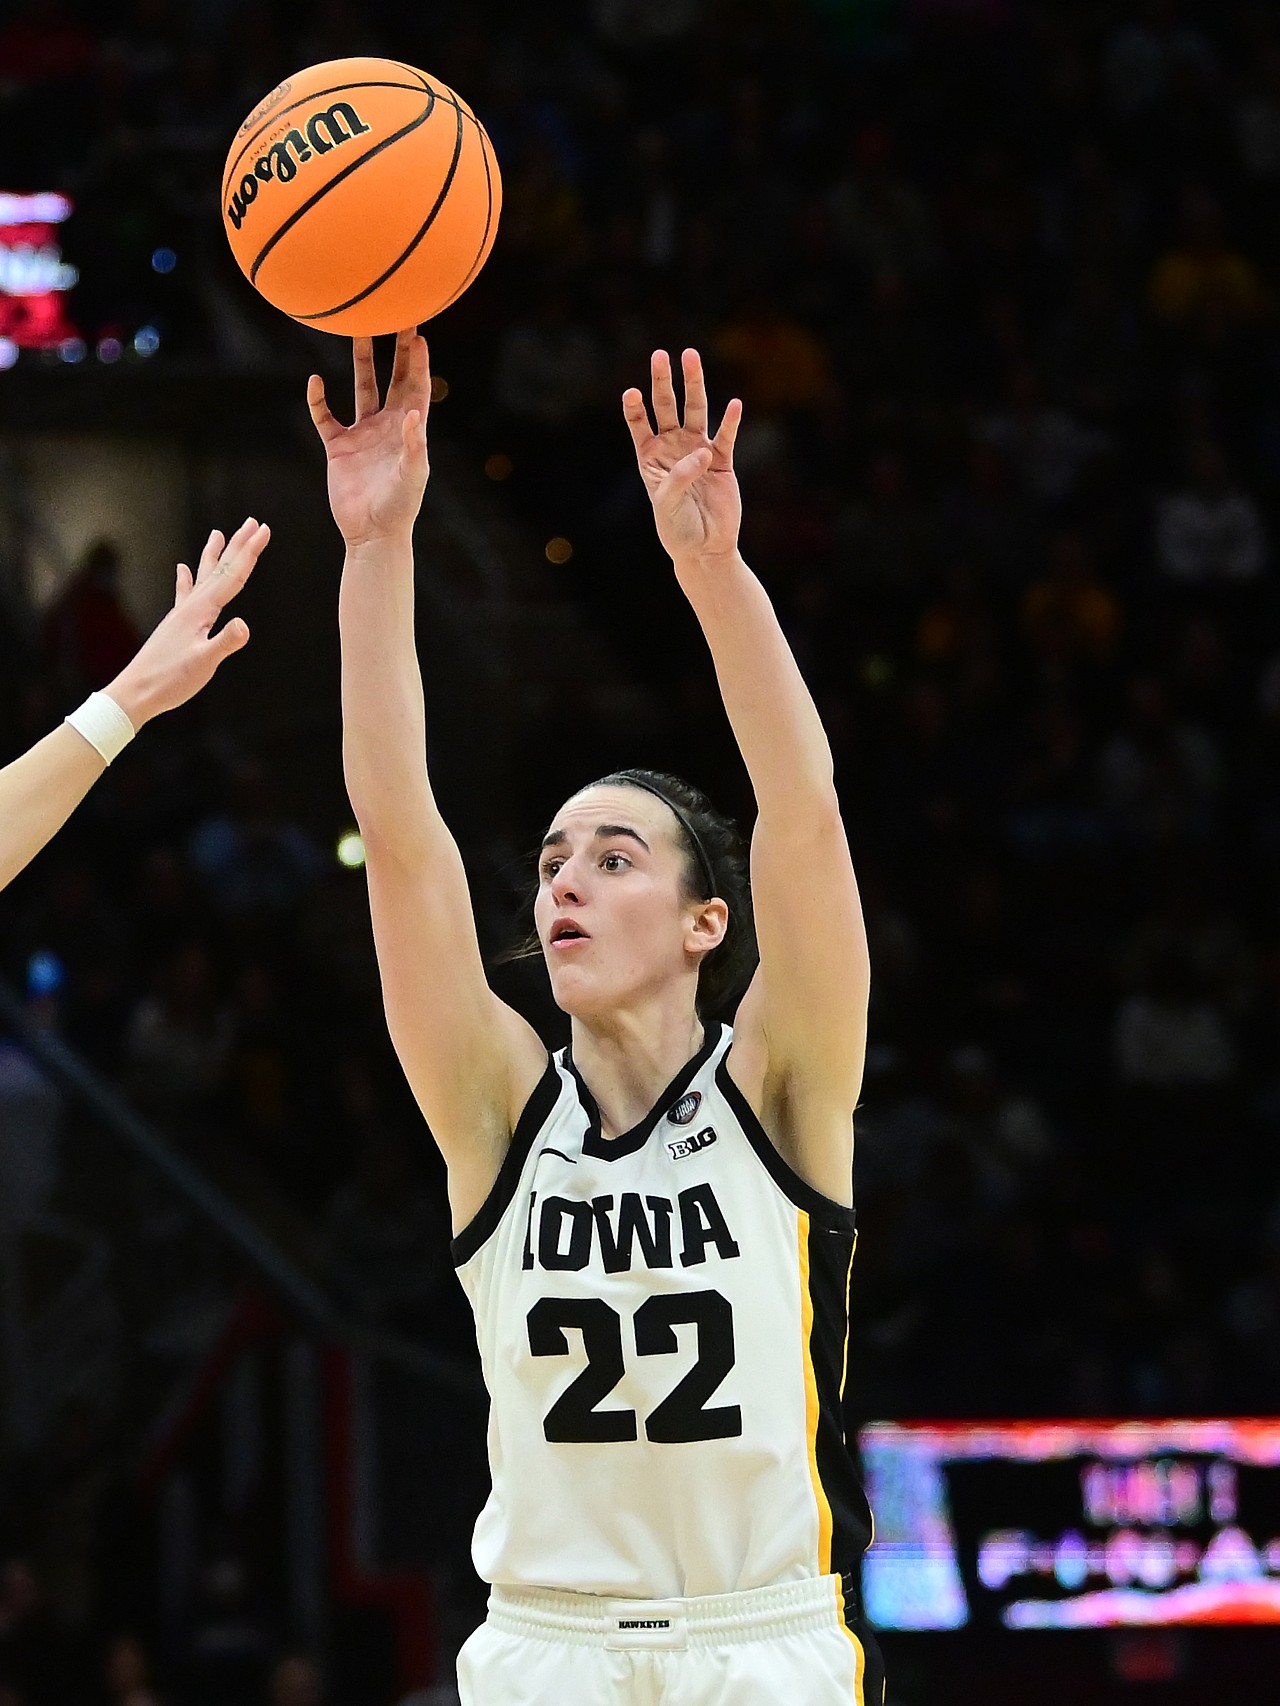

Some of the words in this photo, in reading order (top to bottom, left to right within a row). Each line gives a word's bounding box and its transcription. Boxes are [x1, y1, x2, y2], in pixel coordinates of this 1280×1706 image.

[228, 102, 371, 230] Wilson
[526, 1289, 742, 1443] 22
[618, 1620, 670, 1629] HAWKEYES
